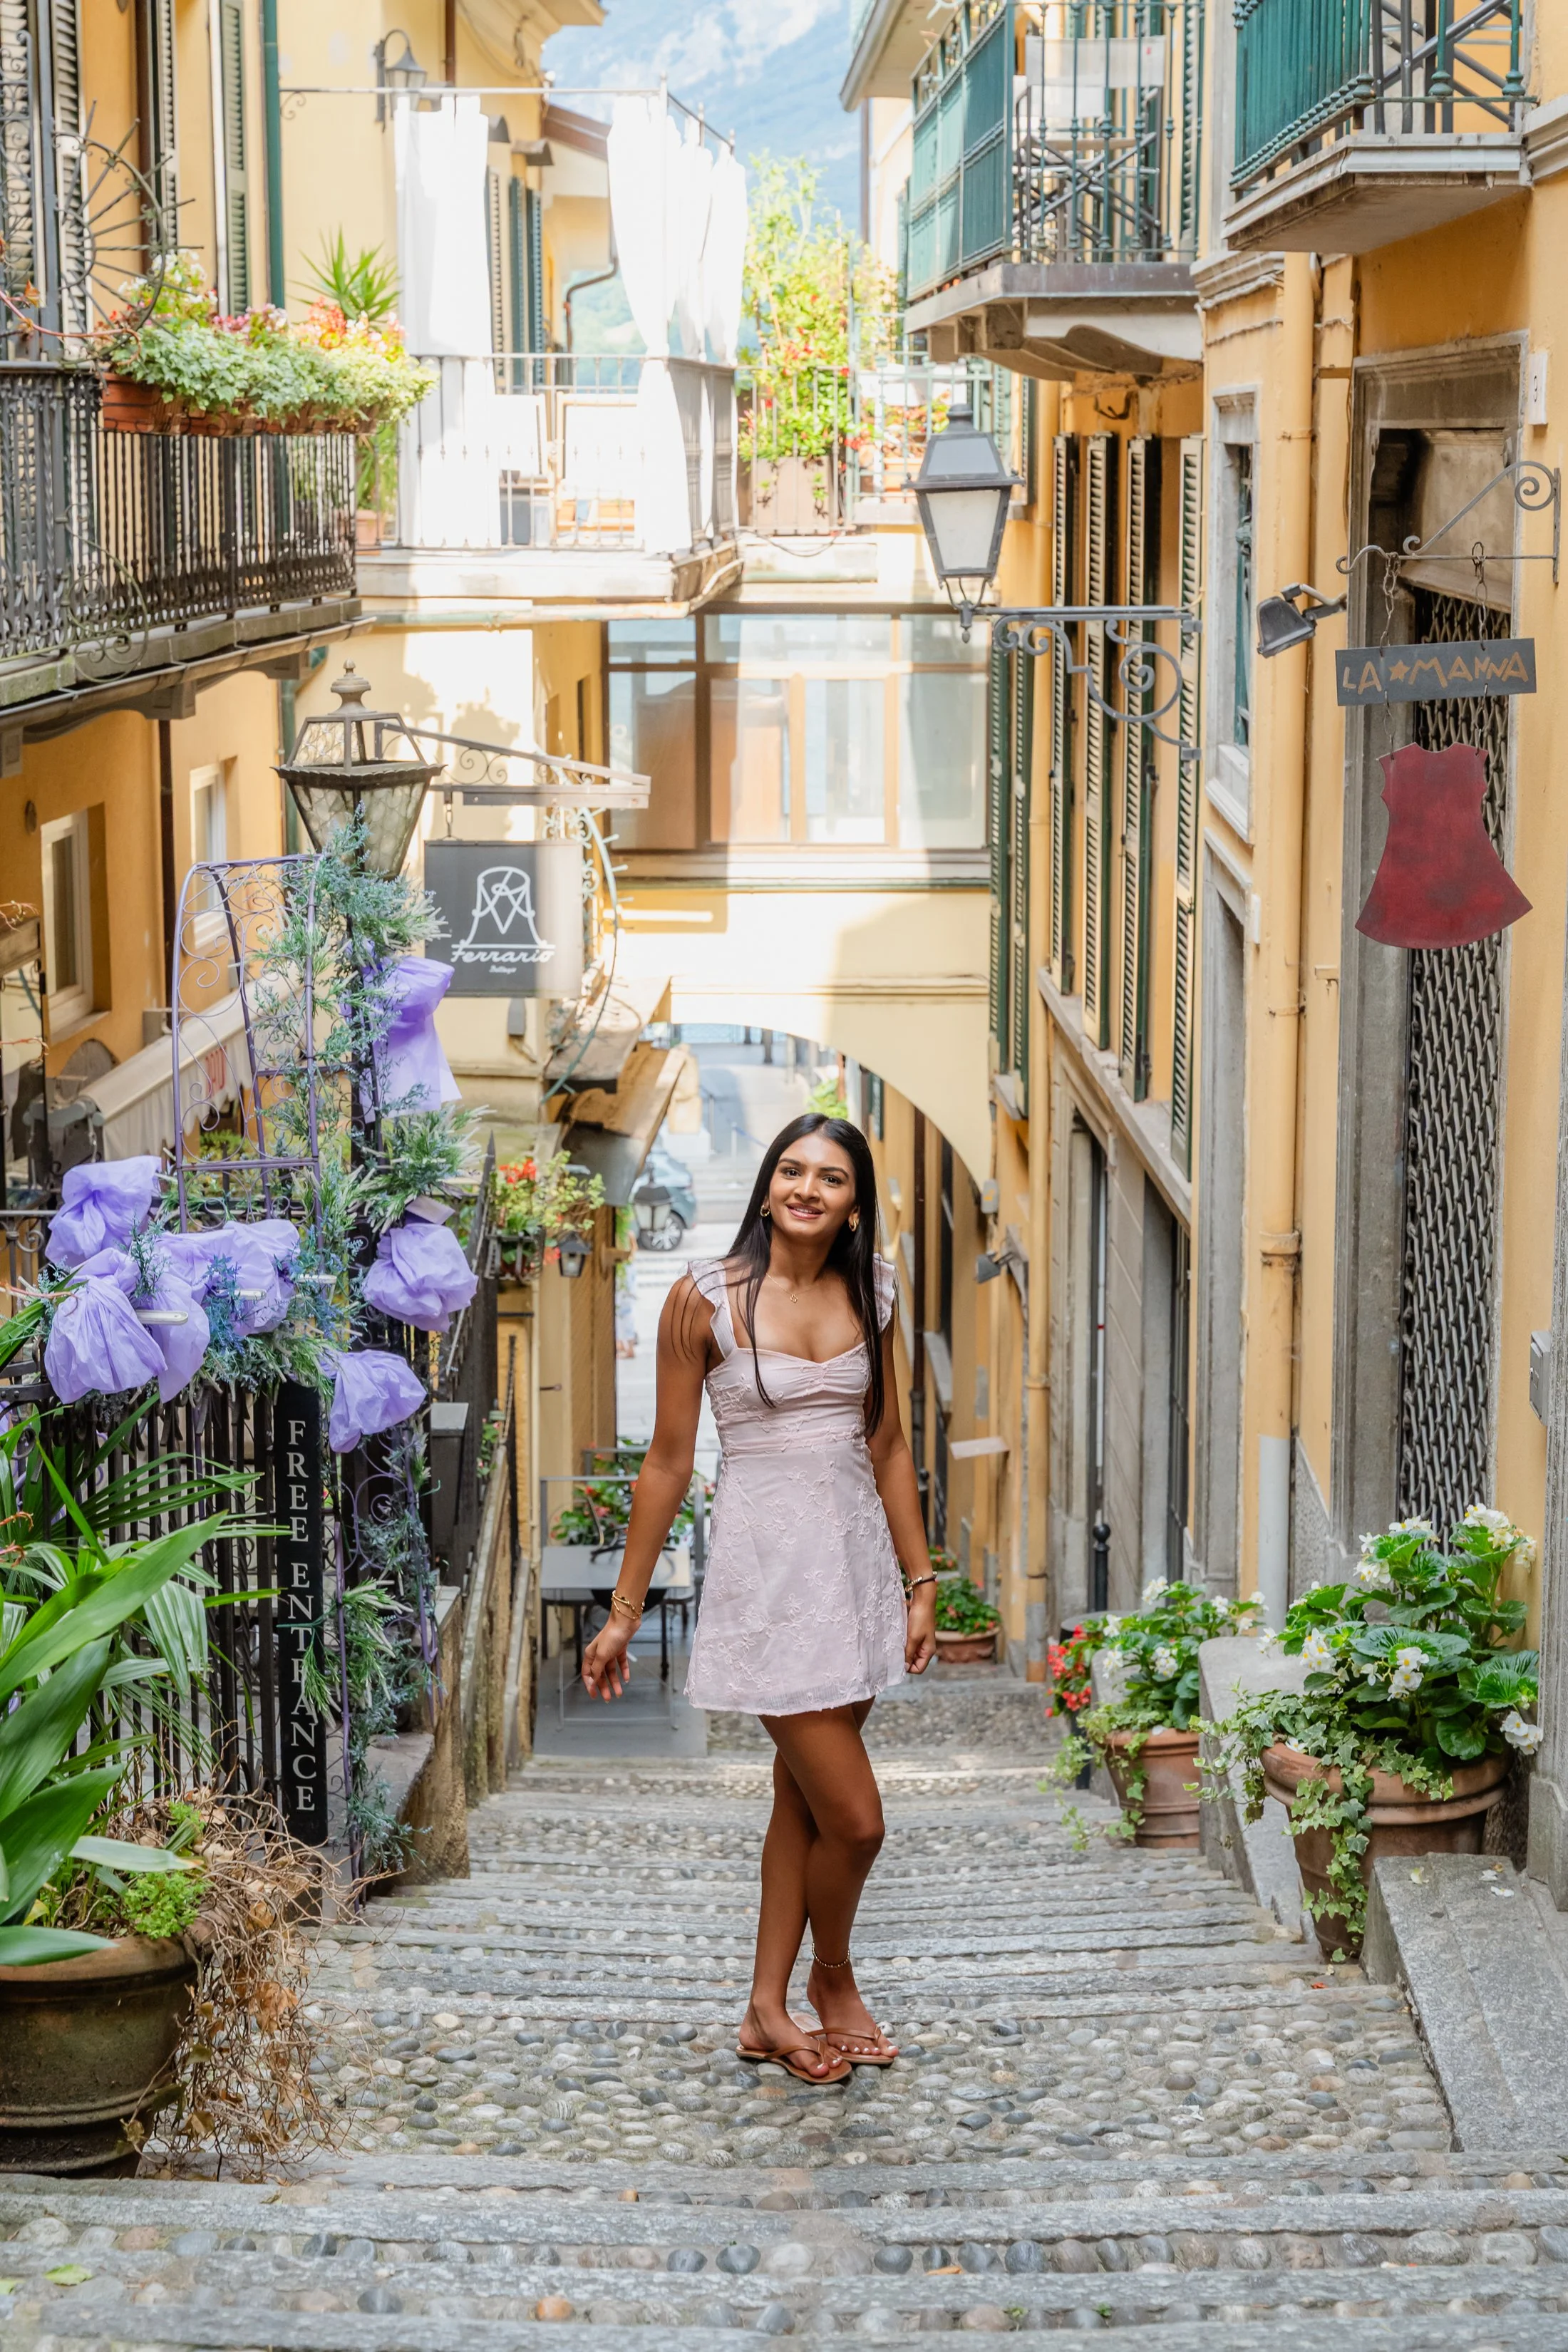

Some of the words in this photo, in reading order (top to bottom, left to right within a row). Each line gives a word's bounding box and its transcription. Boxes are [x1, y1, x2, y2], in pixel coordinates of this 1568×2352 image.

[1343, 661, 1383, 695] LA
[1408, 651, 1529, 689] MANNA
[450, 944, 556, 963] Ferrario
[287, 1420, 309, 1542] FREE
